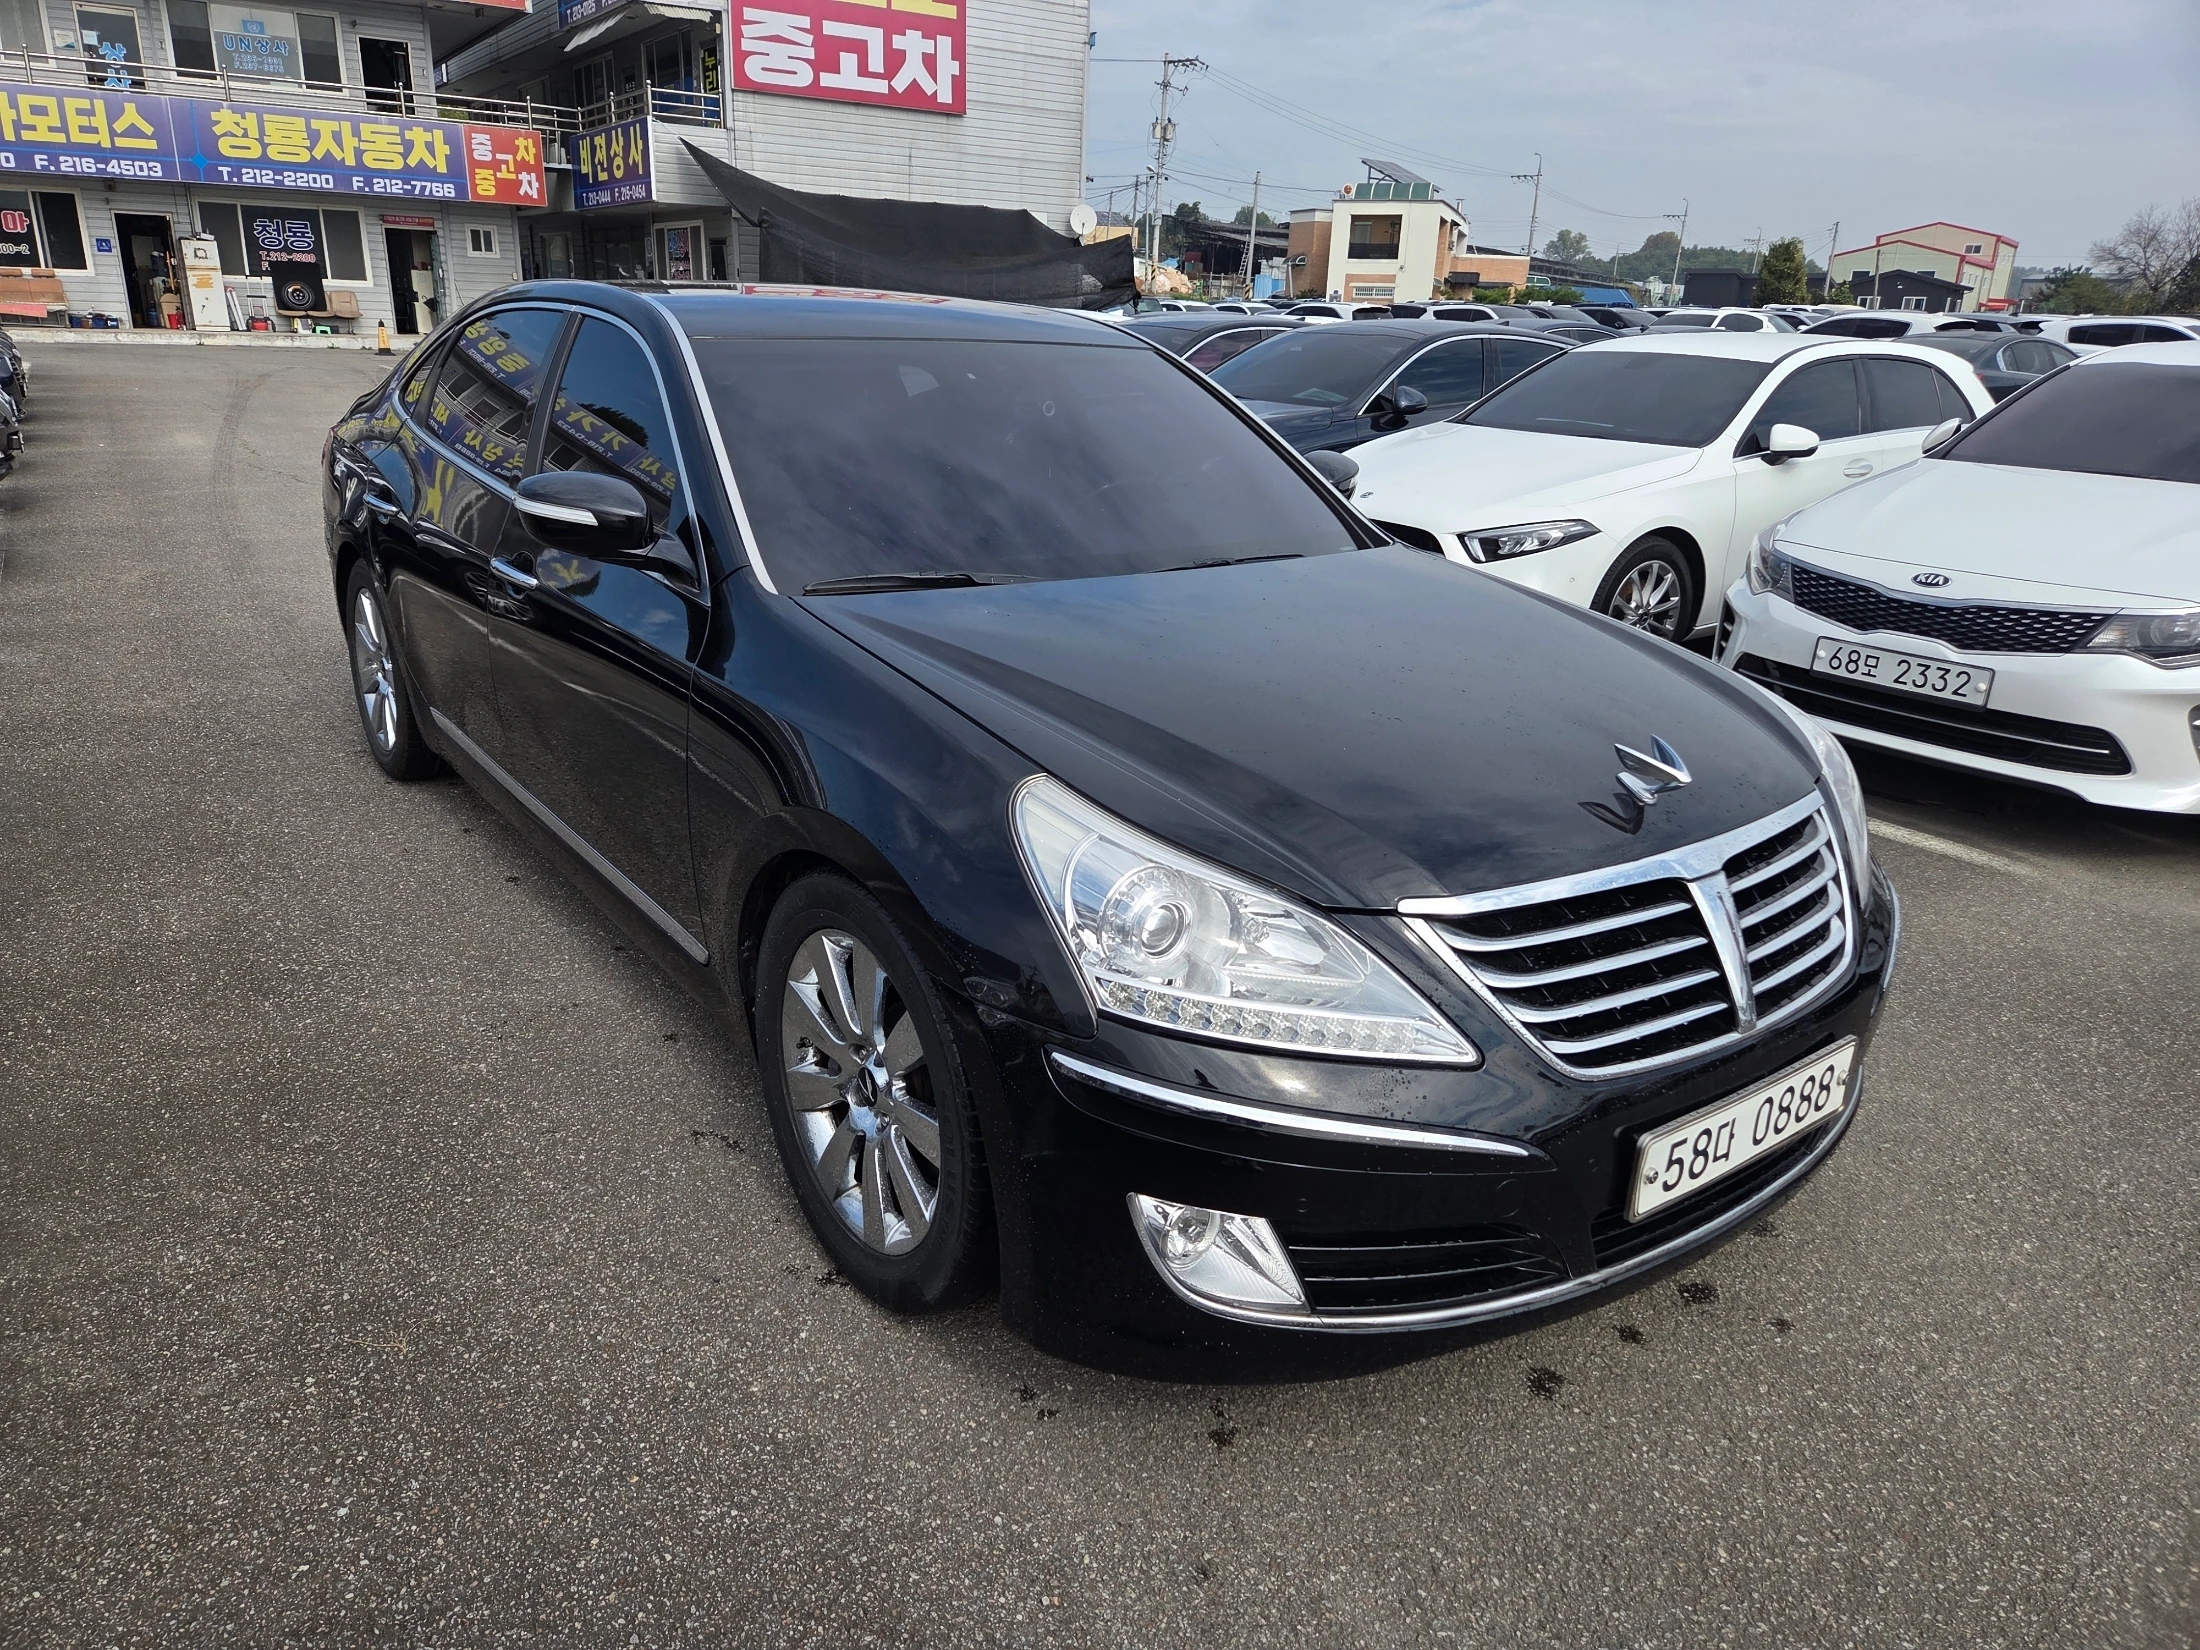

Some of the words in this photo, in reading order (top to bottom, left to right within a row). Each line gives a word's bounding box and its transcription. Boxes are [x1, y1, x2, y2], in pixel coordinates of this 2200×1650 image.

[740, 7, 960, 104] 중고차
[0, 152, 16, 168] 0
[211, 108, 451, 174] 청룡자동차
[253, 218, 315, 251] 청룡
[1915, 573, 1945, 586] KIA
[1828, 646, 1880, 678] 68모
[1893, 659, 1972, 698] 2332
[1752, 1064, 1835, 1147] 0888
